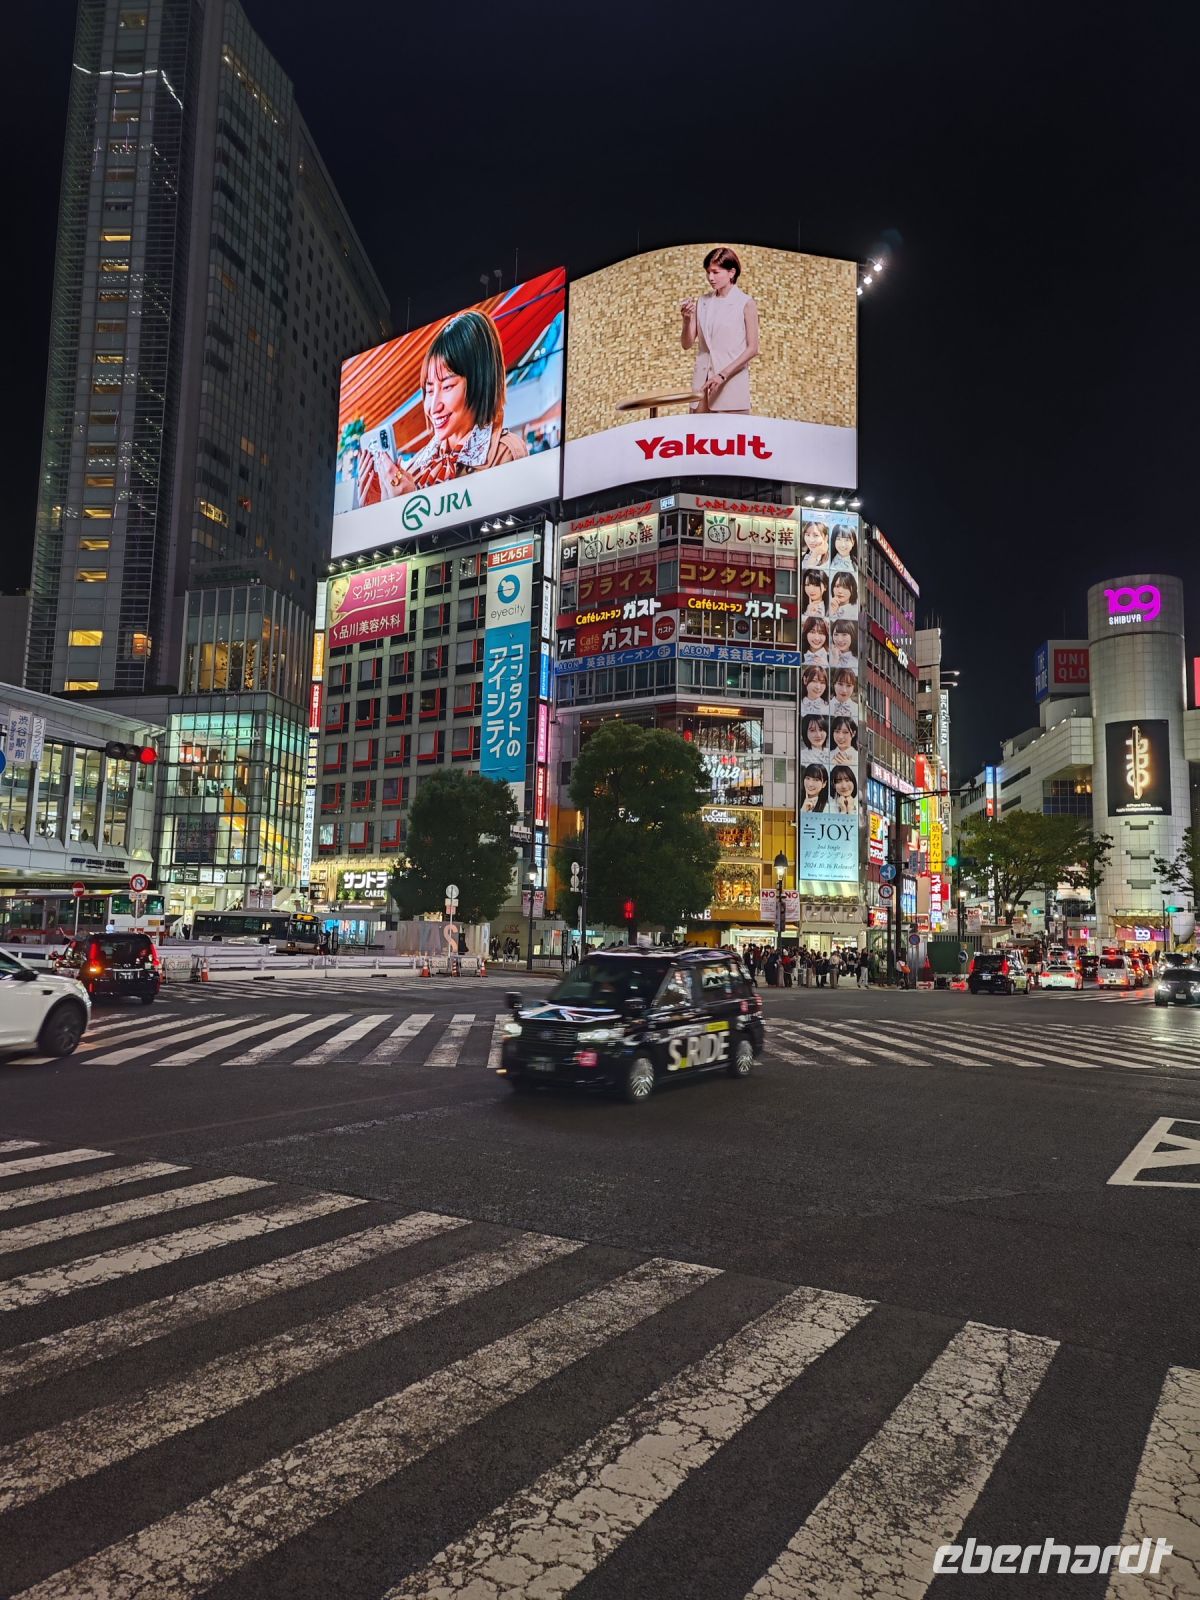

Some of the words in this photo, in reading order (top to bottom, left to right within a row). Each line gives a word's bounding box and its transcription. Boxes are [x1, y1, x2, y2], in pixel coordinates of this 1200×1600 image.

[635, 434, 773, 460] Yakult
[434, 489, 473, 516] JRA
[695, 497, 794, 517] しゃぶしゃぶバイキング
[606, 525, 653, 550] しゃぶ葉
[736, 523, 794, 546] しゃぶ葉
[492, 547, 529, 565] 当ビル5F
[563, 546, 577, 559] 9F
[363, 571, 403, 590] 品川スキン
[580, 570, 654, 600] プライス
[680, 563, 772, 588] コンタクト
[363, 585, 398, 602] クリニック
[1104, 585, 1161, 622] 109
[490, 604, 525, 621] eyecity
[623, 598, 662, 620] ガスト
[745, 600, 788, 619] ガスト
[1108, 613, 1142, 625] SHIBUYA
[339, 613, 401, 639] 品川美容外科
[559, 639, 575, 653] 7F
[601, 625, 647, 651] ガスト
[683, 646, 710, 655] AEON
[1058, 653, 1084, 665] UNI
[1058, 667, 1088, 681] QLO
[486, 646, 508, 758] アイシティ
[506, 644, 524, 757] コンタクトの
[15, 715, 29, 760] 渋谷駅前
